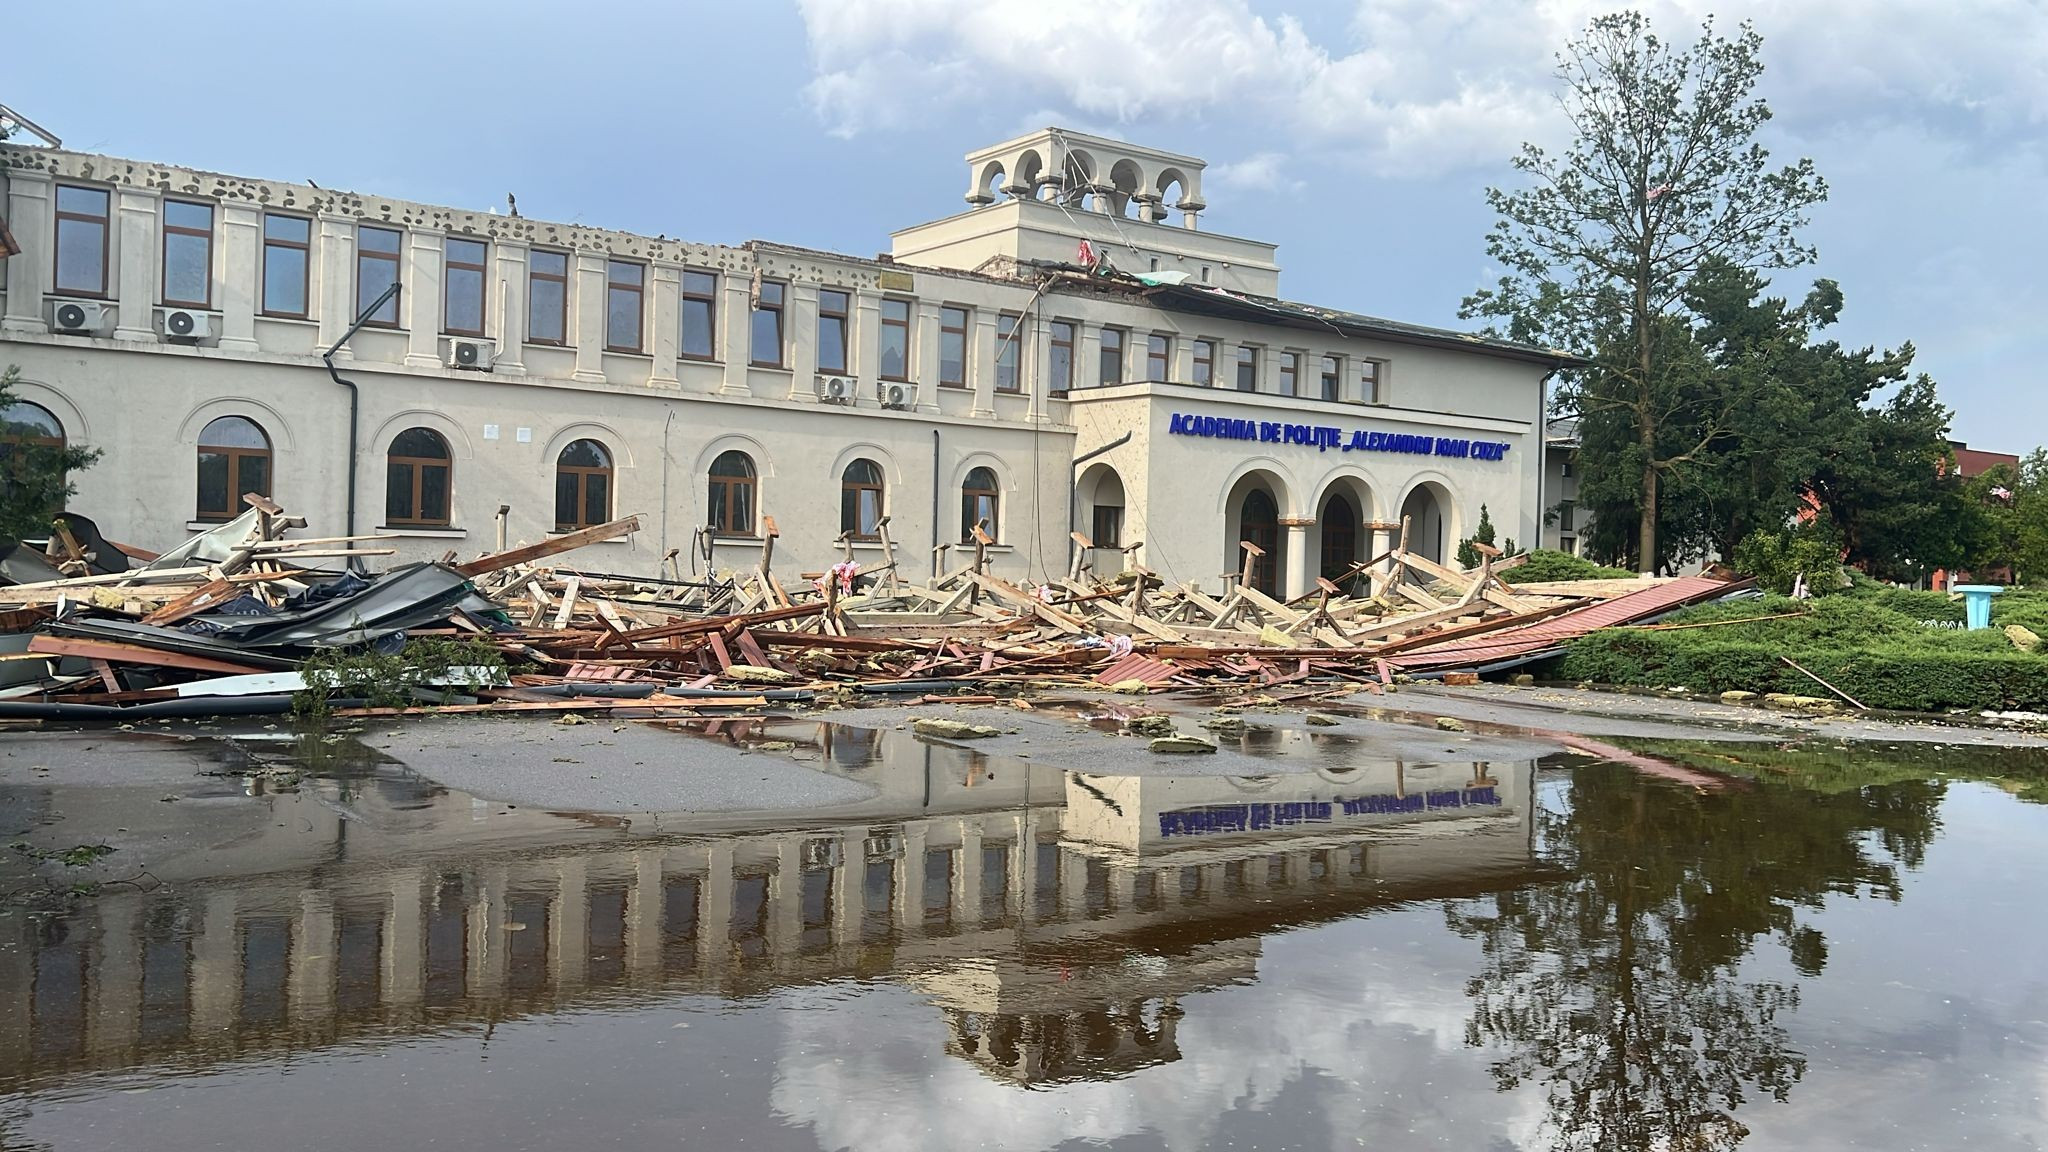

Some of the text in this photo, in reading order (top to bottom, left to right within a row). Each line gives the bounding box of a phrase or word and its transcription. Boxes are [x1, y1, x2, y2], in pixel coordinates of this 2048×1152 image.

[1169, 413, 1258, 441] ACADEMIA
[1260, 421, 1281, 443] DE
[1435, 437, 1469, 458] IOAN
